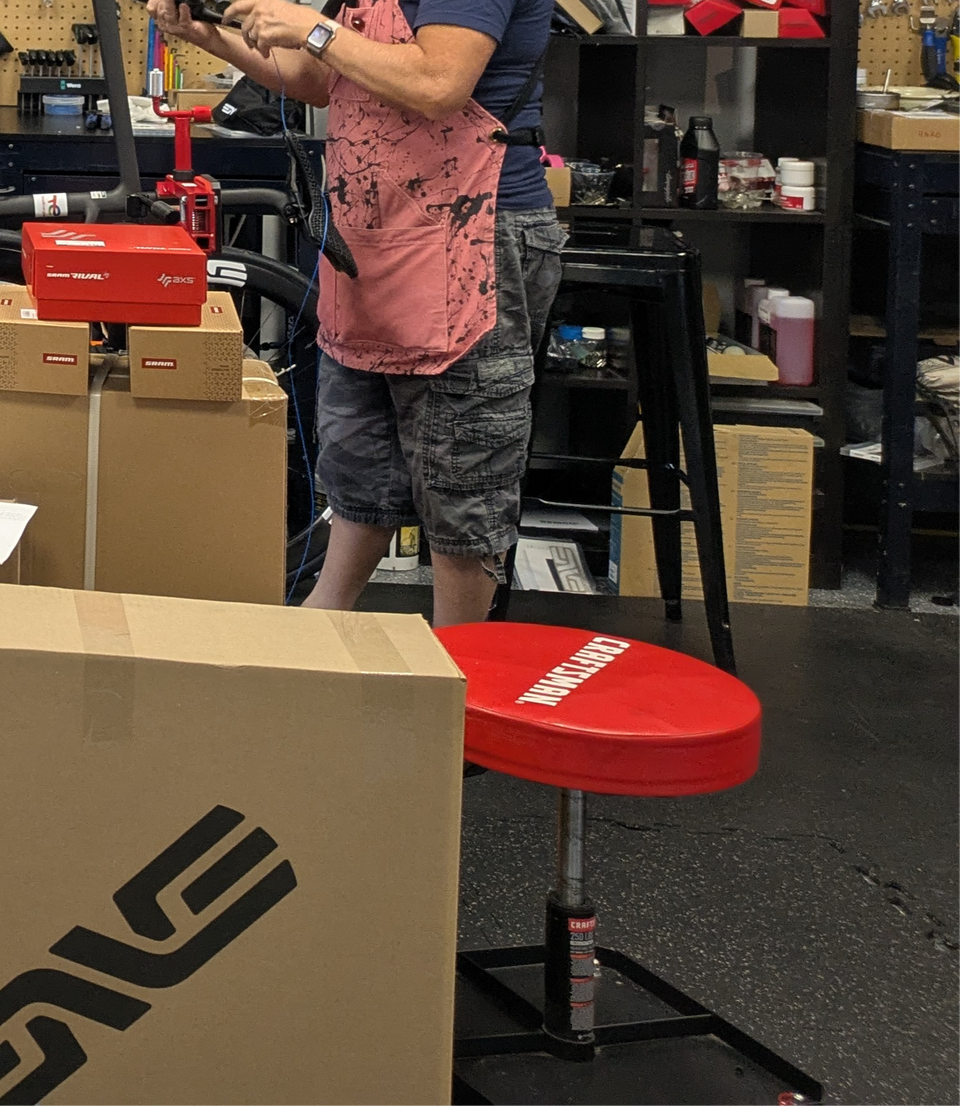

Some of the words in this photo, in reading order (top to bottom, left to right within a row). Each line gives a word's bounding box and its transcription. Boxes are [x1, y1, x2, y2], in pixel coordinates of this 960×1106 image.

[70, 273, 104, 281] RIVAL
[46, 355, 75, 364] SRAM
[144, 360, 174, 368] SRAM
[515, 636, 631, 707] CRAFTSMAN
